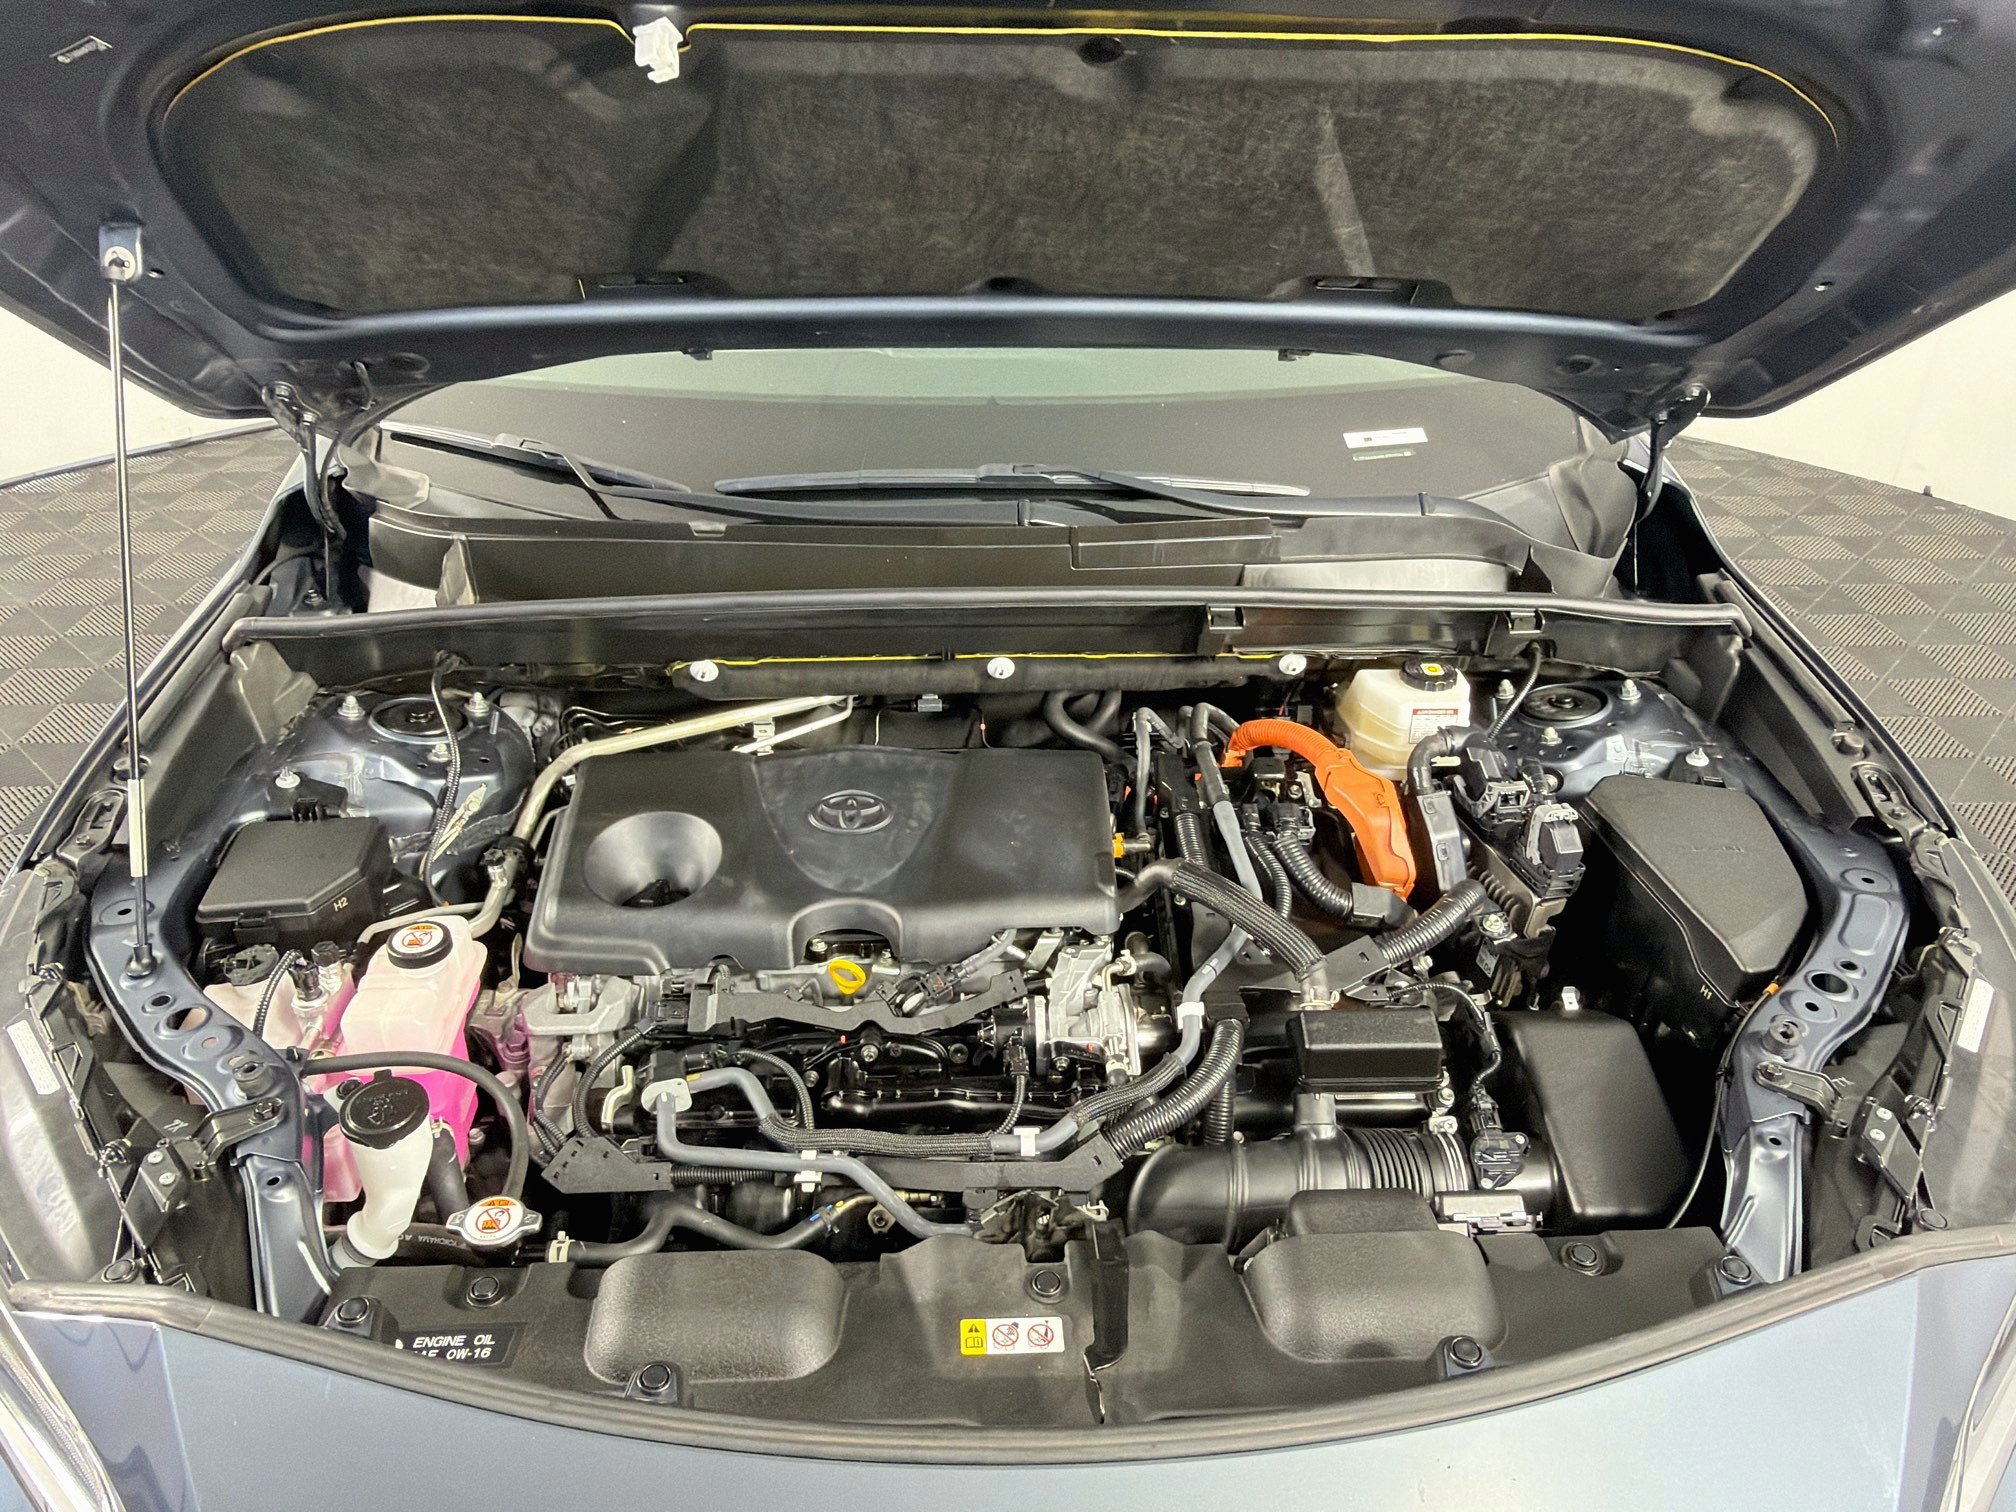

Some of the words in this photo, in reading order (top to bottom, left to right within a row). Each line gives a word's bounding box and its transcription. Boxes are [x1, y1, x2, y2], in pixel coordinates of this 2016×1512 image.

[333, 896, 348, 912] H2
[1699, 984, 1713, 1000] H1
[412, 1335, 467, 1349] ENGINE
[473, 1334, 496, 1346] OIL
